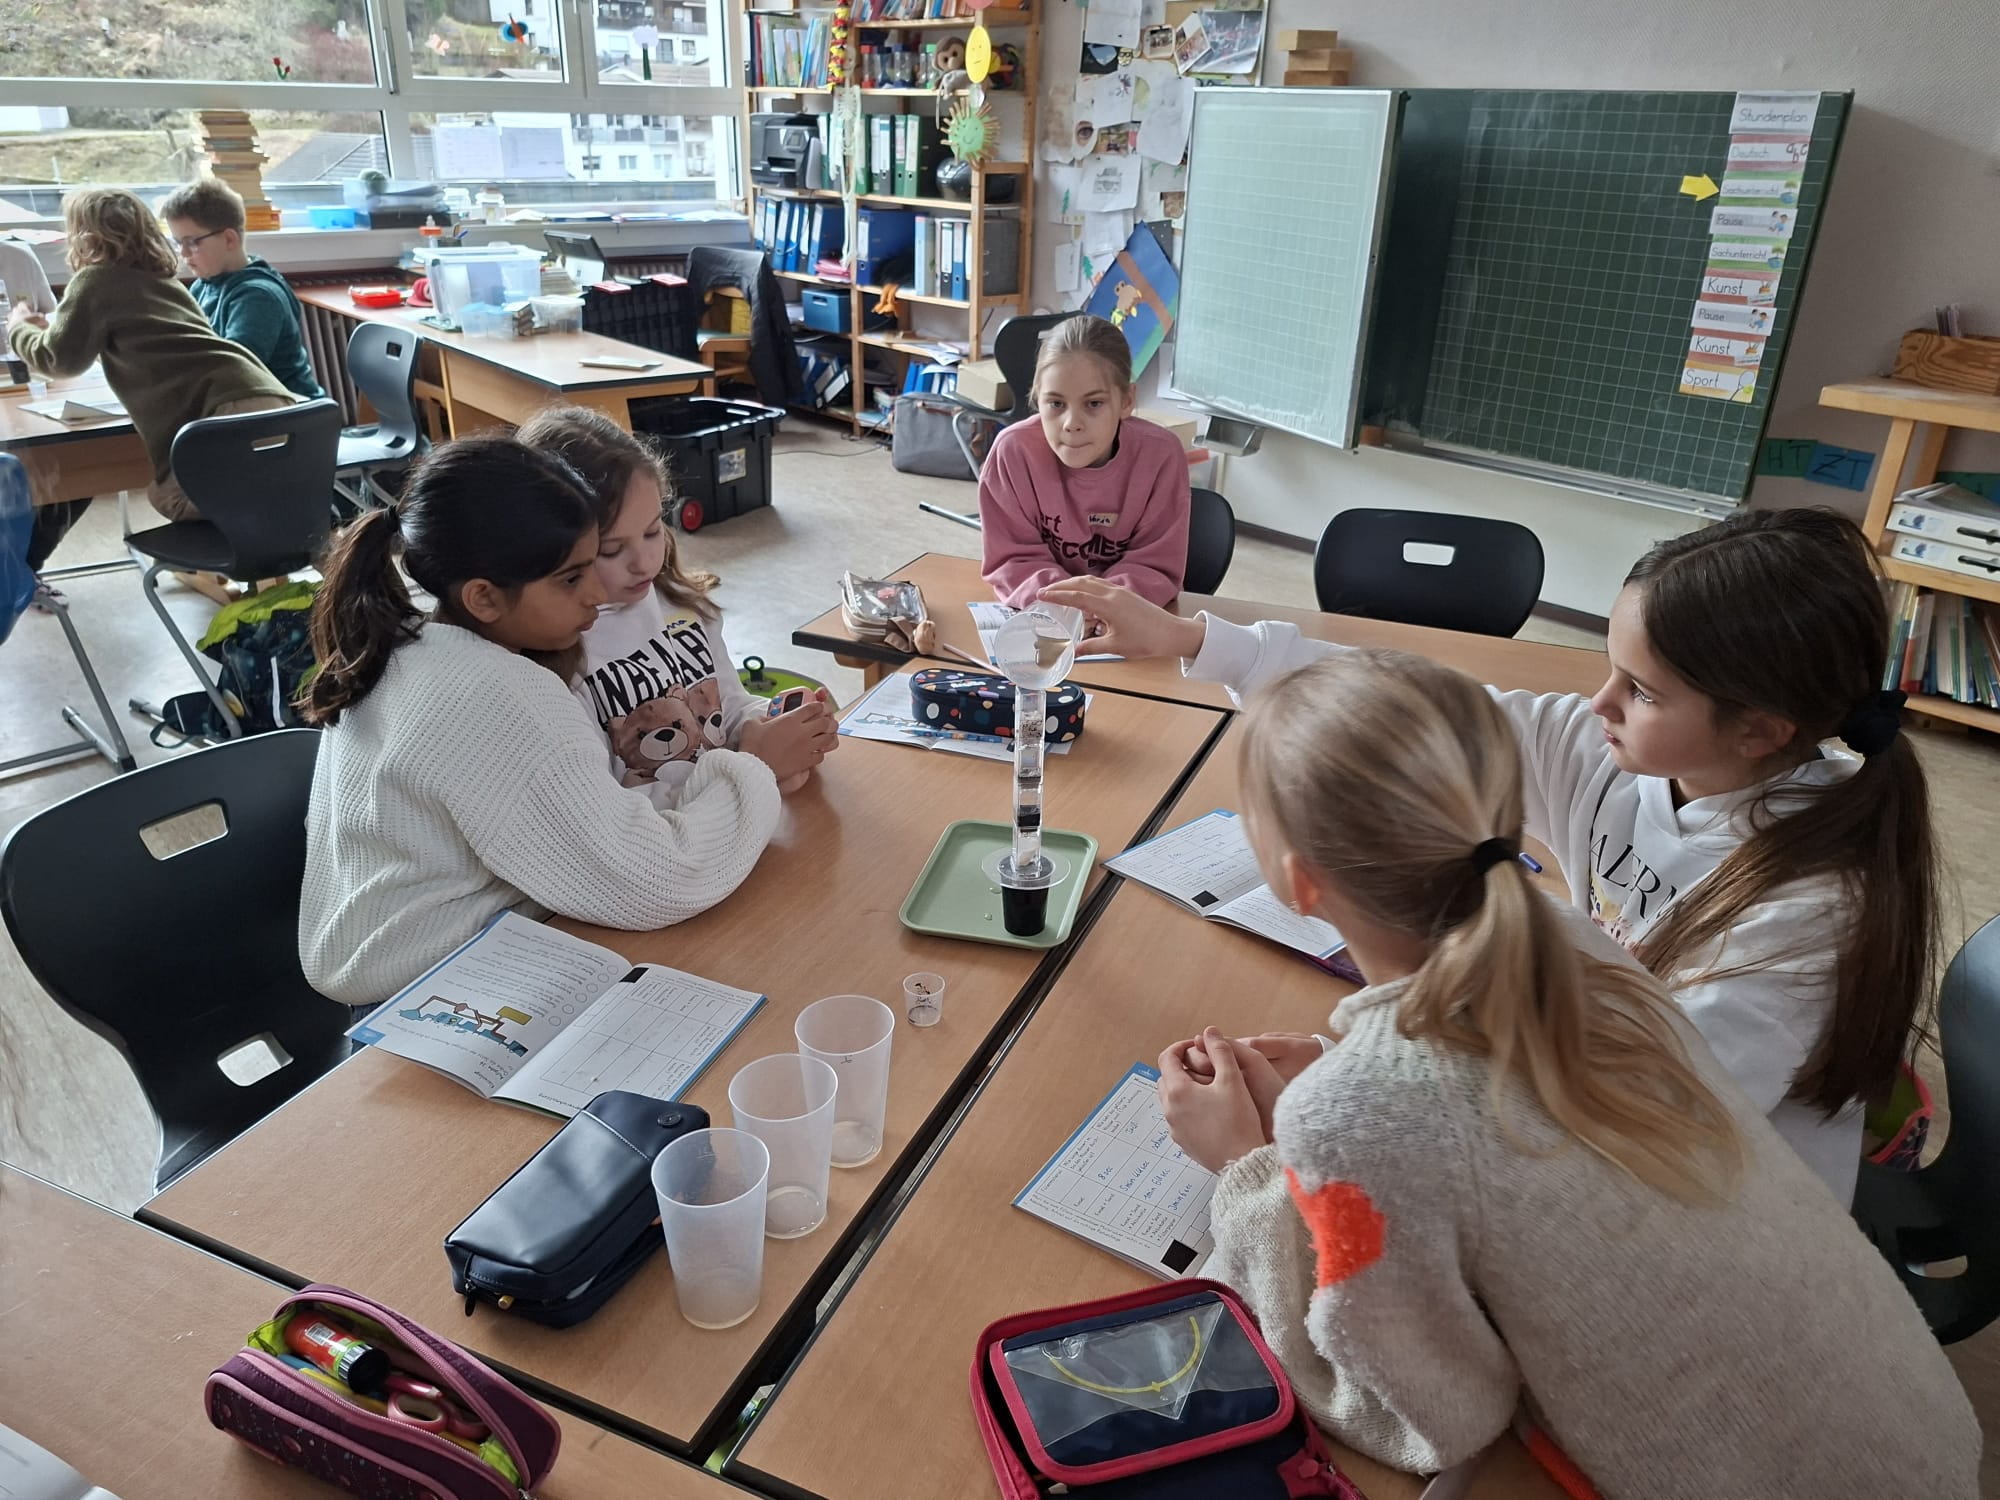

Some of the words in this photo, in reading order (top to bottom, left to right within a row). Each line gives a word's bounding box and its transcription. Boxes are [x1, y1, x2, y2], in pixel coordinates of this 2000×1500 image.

[1740, 108, 1809, 126] Stundenplan
[1717, 213, 1744, 227] Pause
[1711, 247, 1768, 260] Sachunterricht
[1707, 278, 1744, 295] Kunst
[1699, 307, 1725, 321] Pause
[1695, 336, 1731, 355] Kunst
[1684, 369, 1720, 390] Sport
